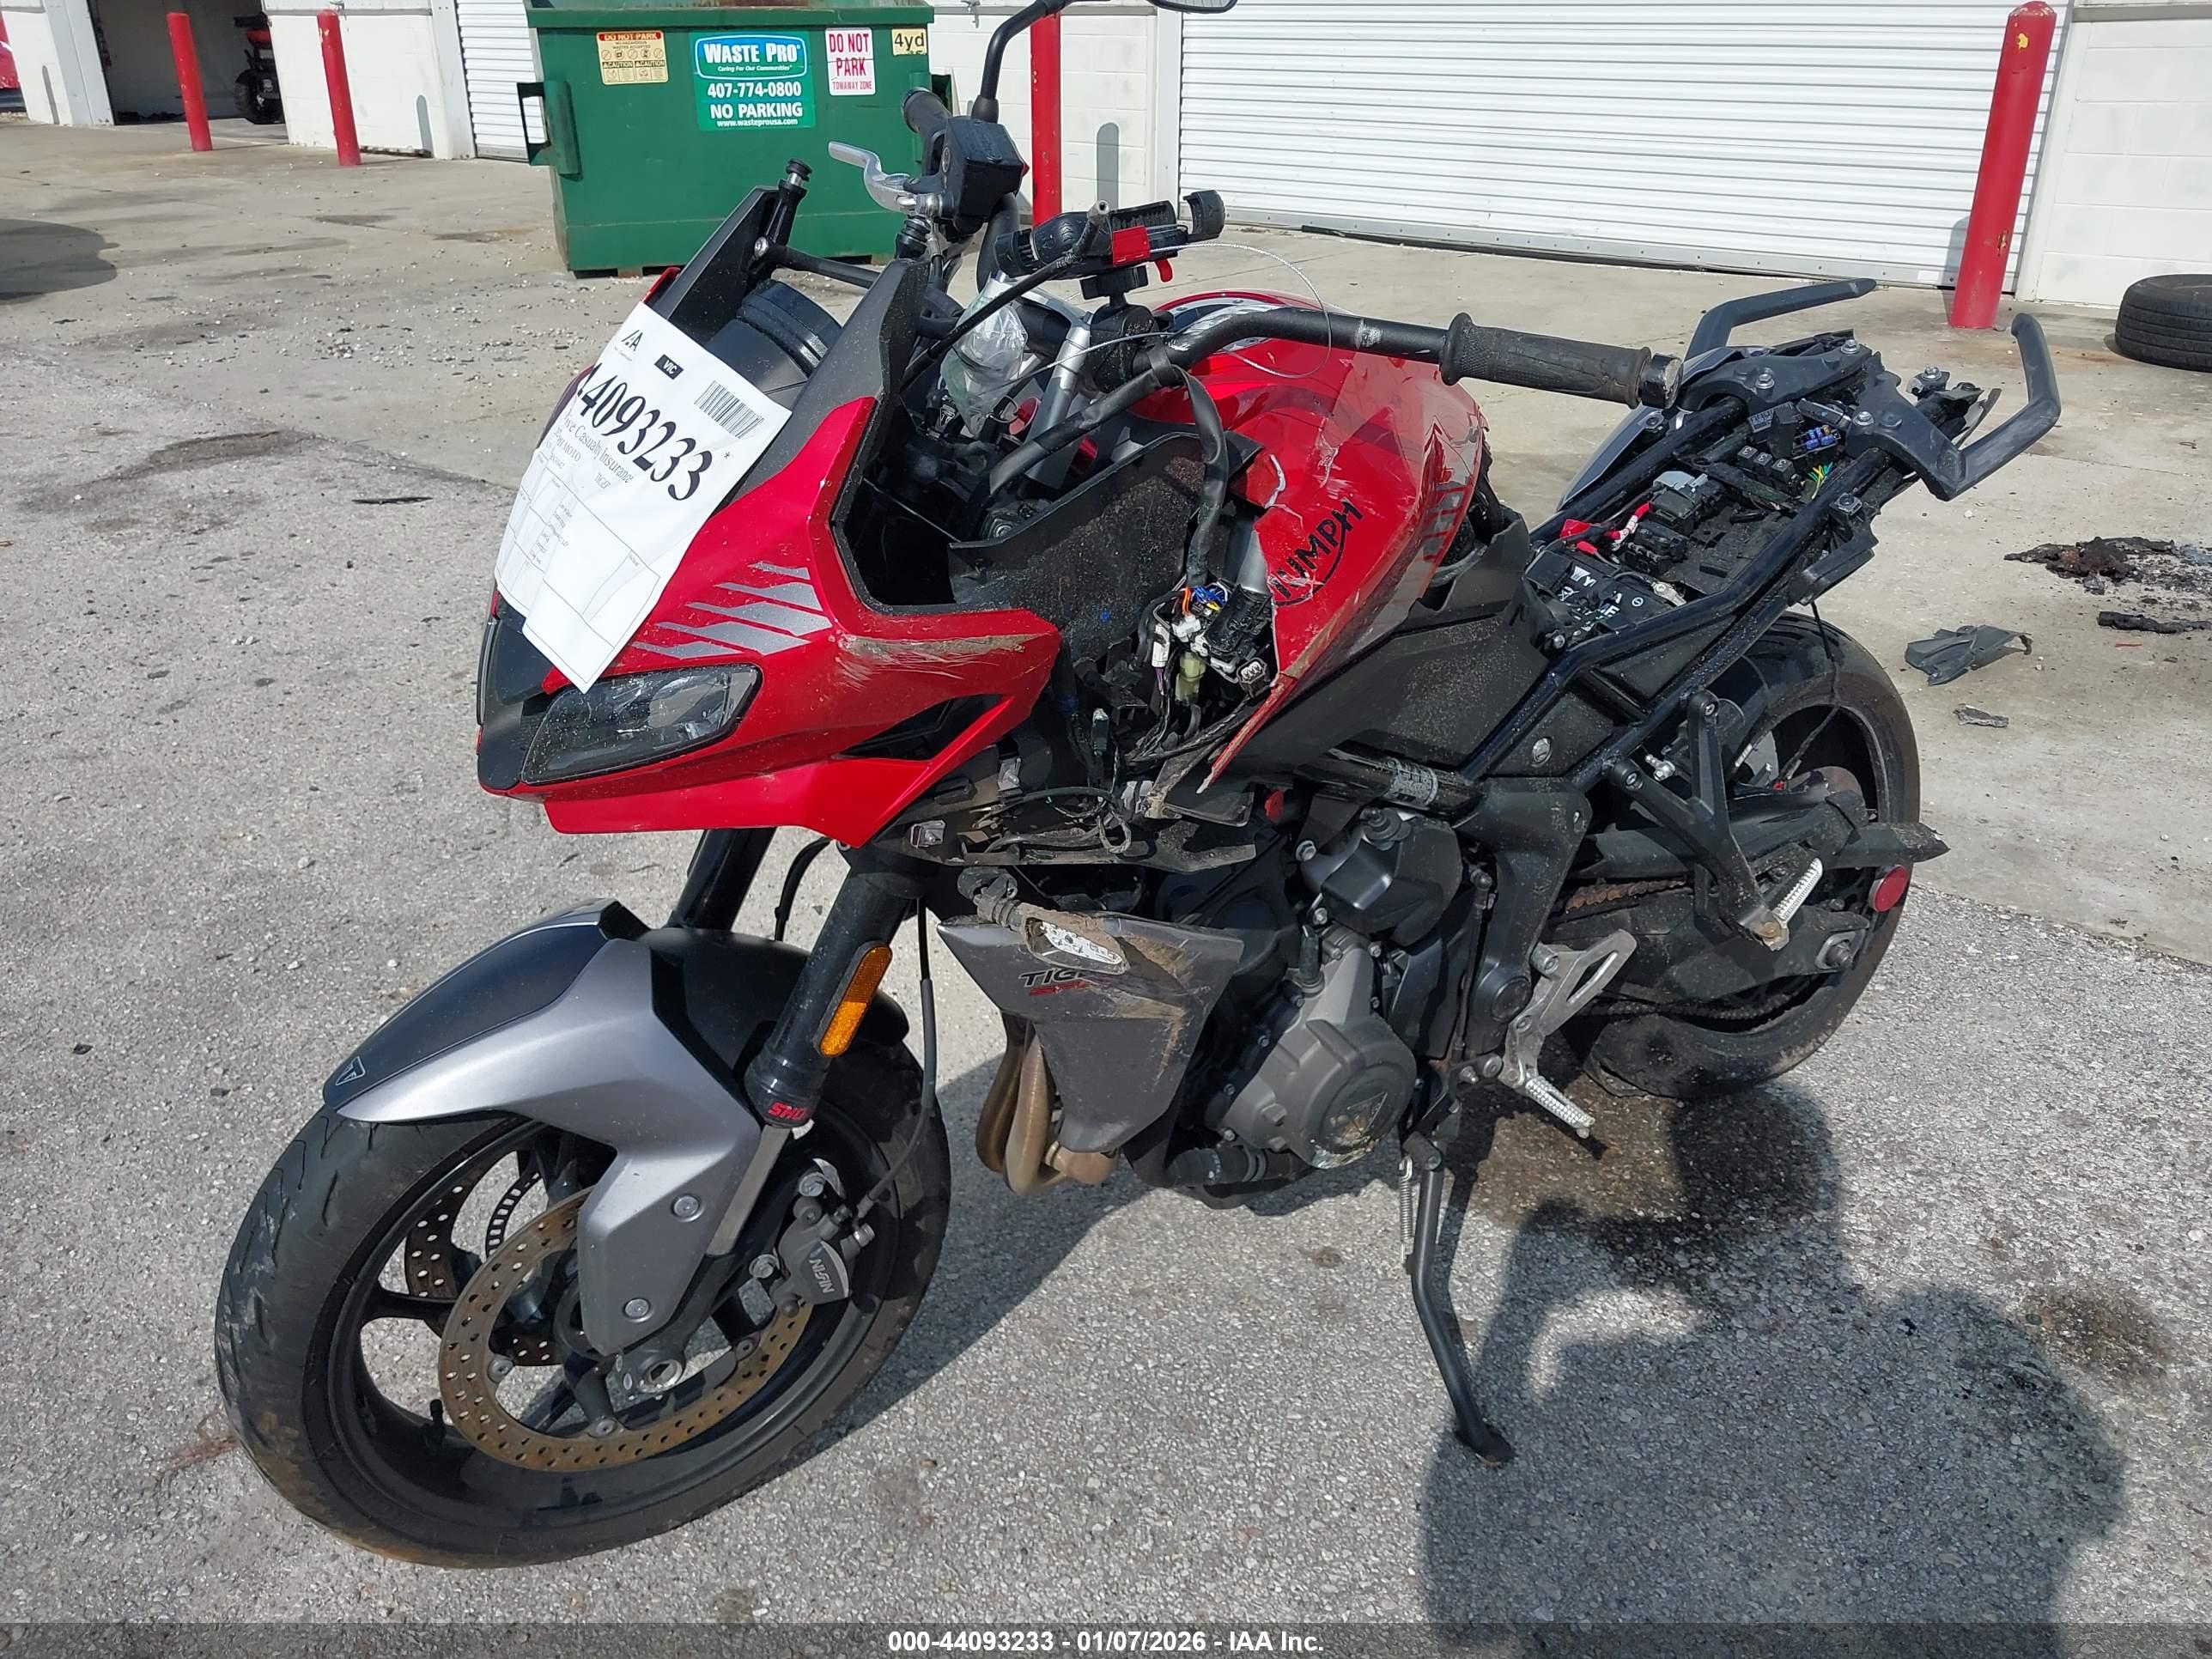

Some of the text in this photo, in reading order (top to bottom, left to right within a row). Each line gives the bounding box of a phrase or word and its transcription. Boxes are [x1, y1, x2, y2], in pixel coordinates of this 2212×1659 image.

[829, 33, 869, 53] DO NOT
[894, 33, 925, 51] 4yd
[703, 42, 798, 64] WASTE PRO
[836, 57, 866, 76] PARK
[707, 81, 802, 98] 407-774-0800
[833, 81, 872, 90] TOWAWAY ZONE
[710, 102, 803, 119] NO PARKING
[716, 118, 799, 127] www.wasteprousa.com
[663, 359, 678, 374] VIC
[599, 447, 634, 483] Insurance
